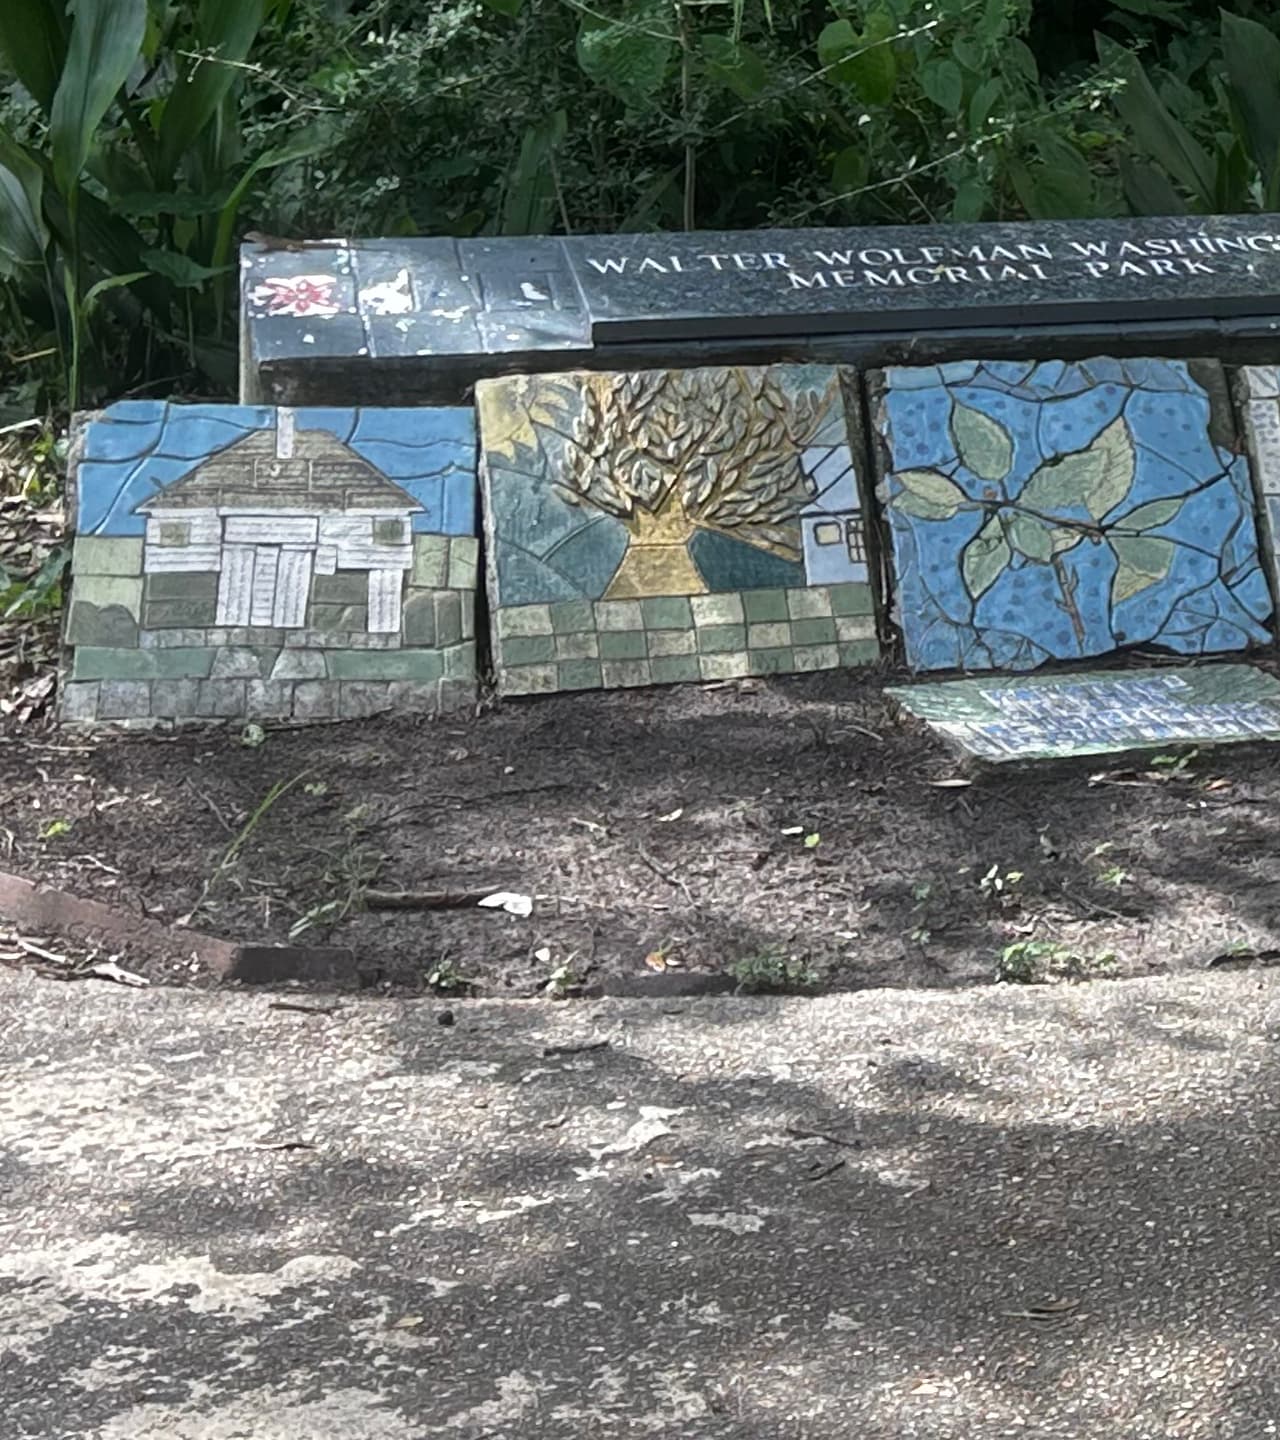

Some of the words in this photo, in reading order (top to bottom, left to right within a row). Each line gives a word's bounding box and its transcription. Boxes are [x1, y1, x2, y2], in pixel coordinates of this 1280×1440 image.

[586, 252, 791, 274] WALTER
[813, 243, 1053, 266] WOLFMAN
[785, 264, 1053, 289] MEMORIAL
[1086, 259, 1216, 279] PARK
